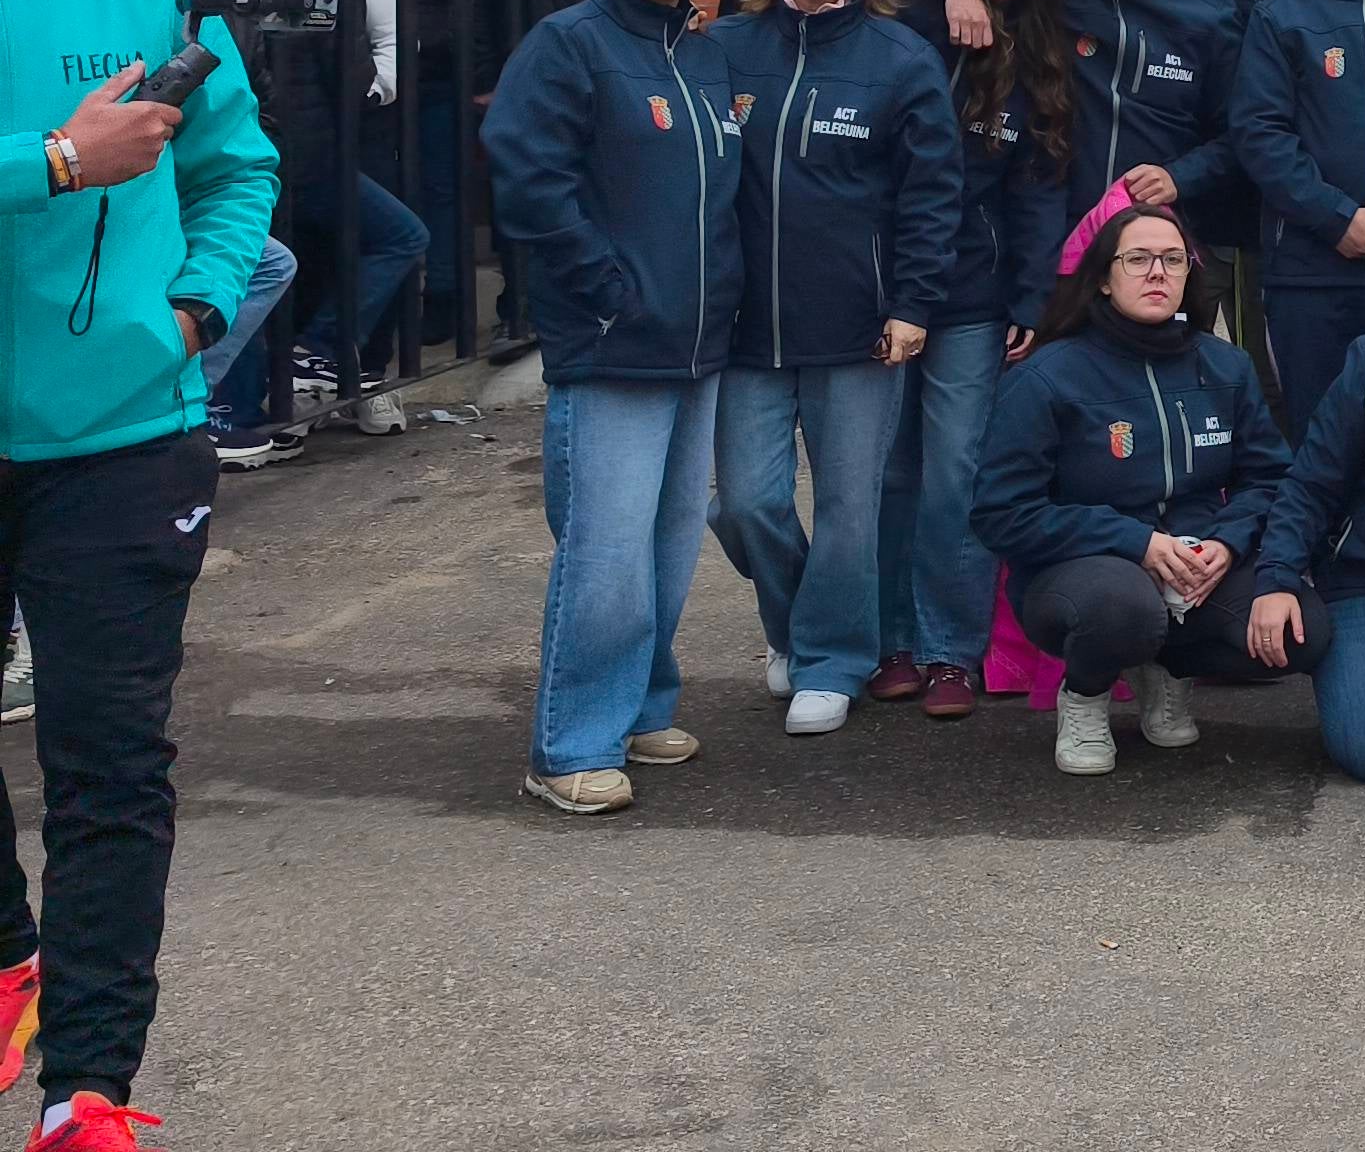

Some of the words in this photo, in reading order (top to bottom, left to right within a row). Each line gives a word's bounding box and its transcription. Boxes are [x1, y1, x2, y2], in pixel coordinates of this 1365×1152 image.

[1165, 53, 1182, 67] ACT
[1147, 64, 1194, 82] BELEGUINA
[834, 107, 858, 122] ACT
[812, 120, 870, 140] BELEGUINA
[1205, 416, 1220, 430] ACT
